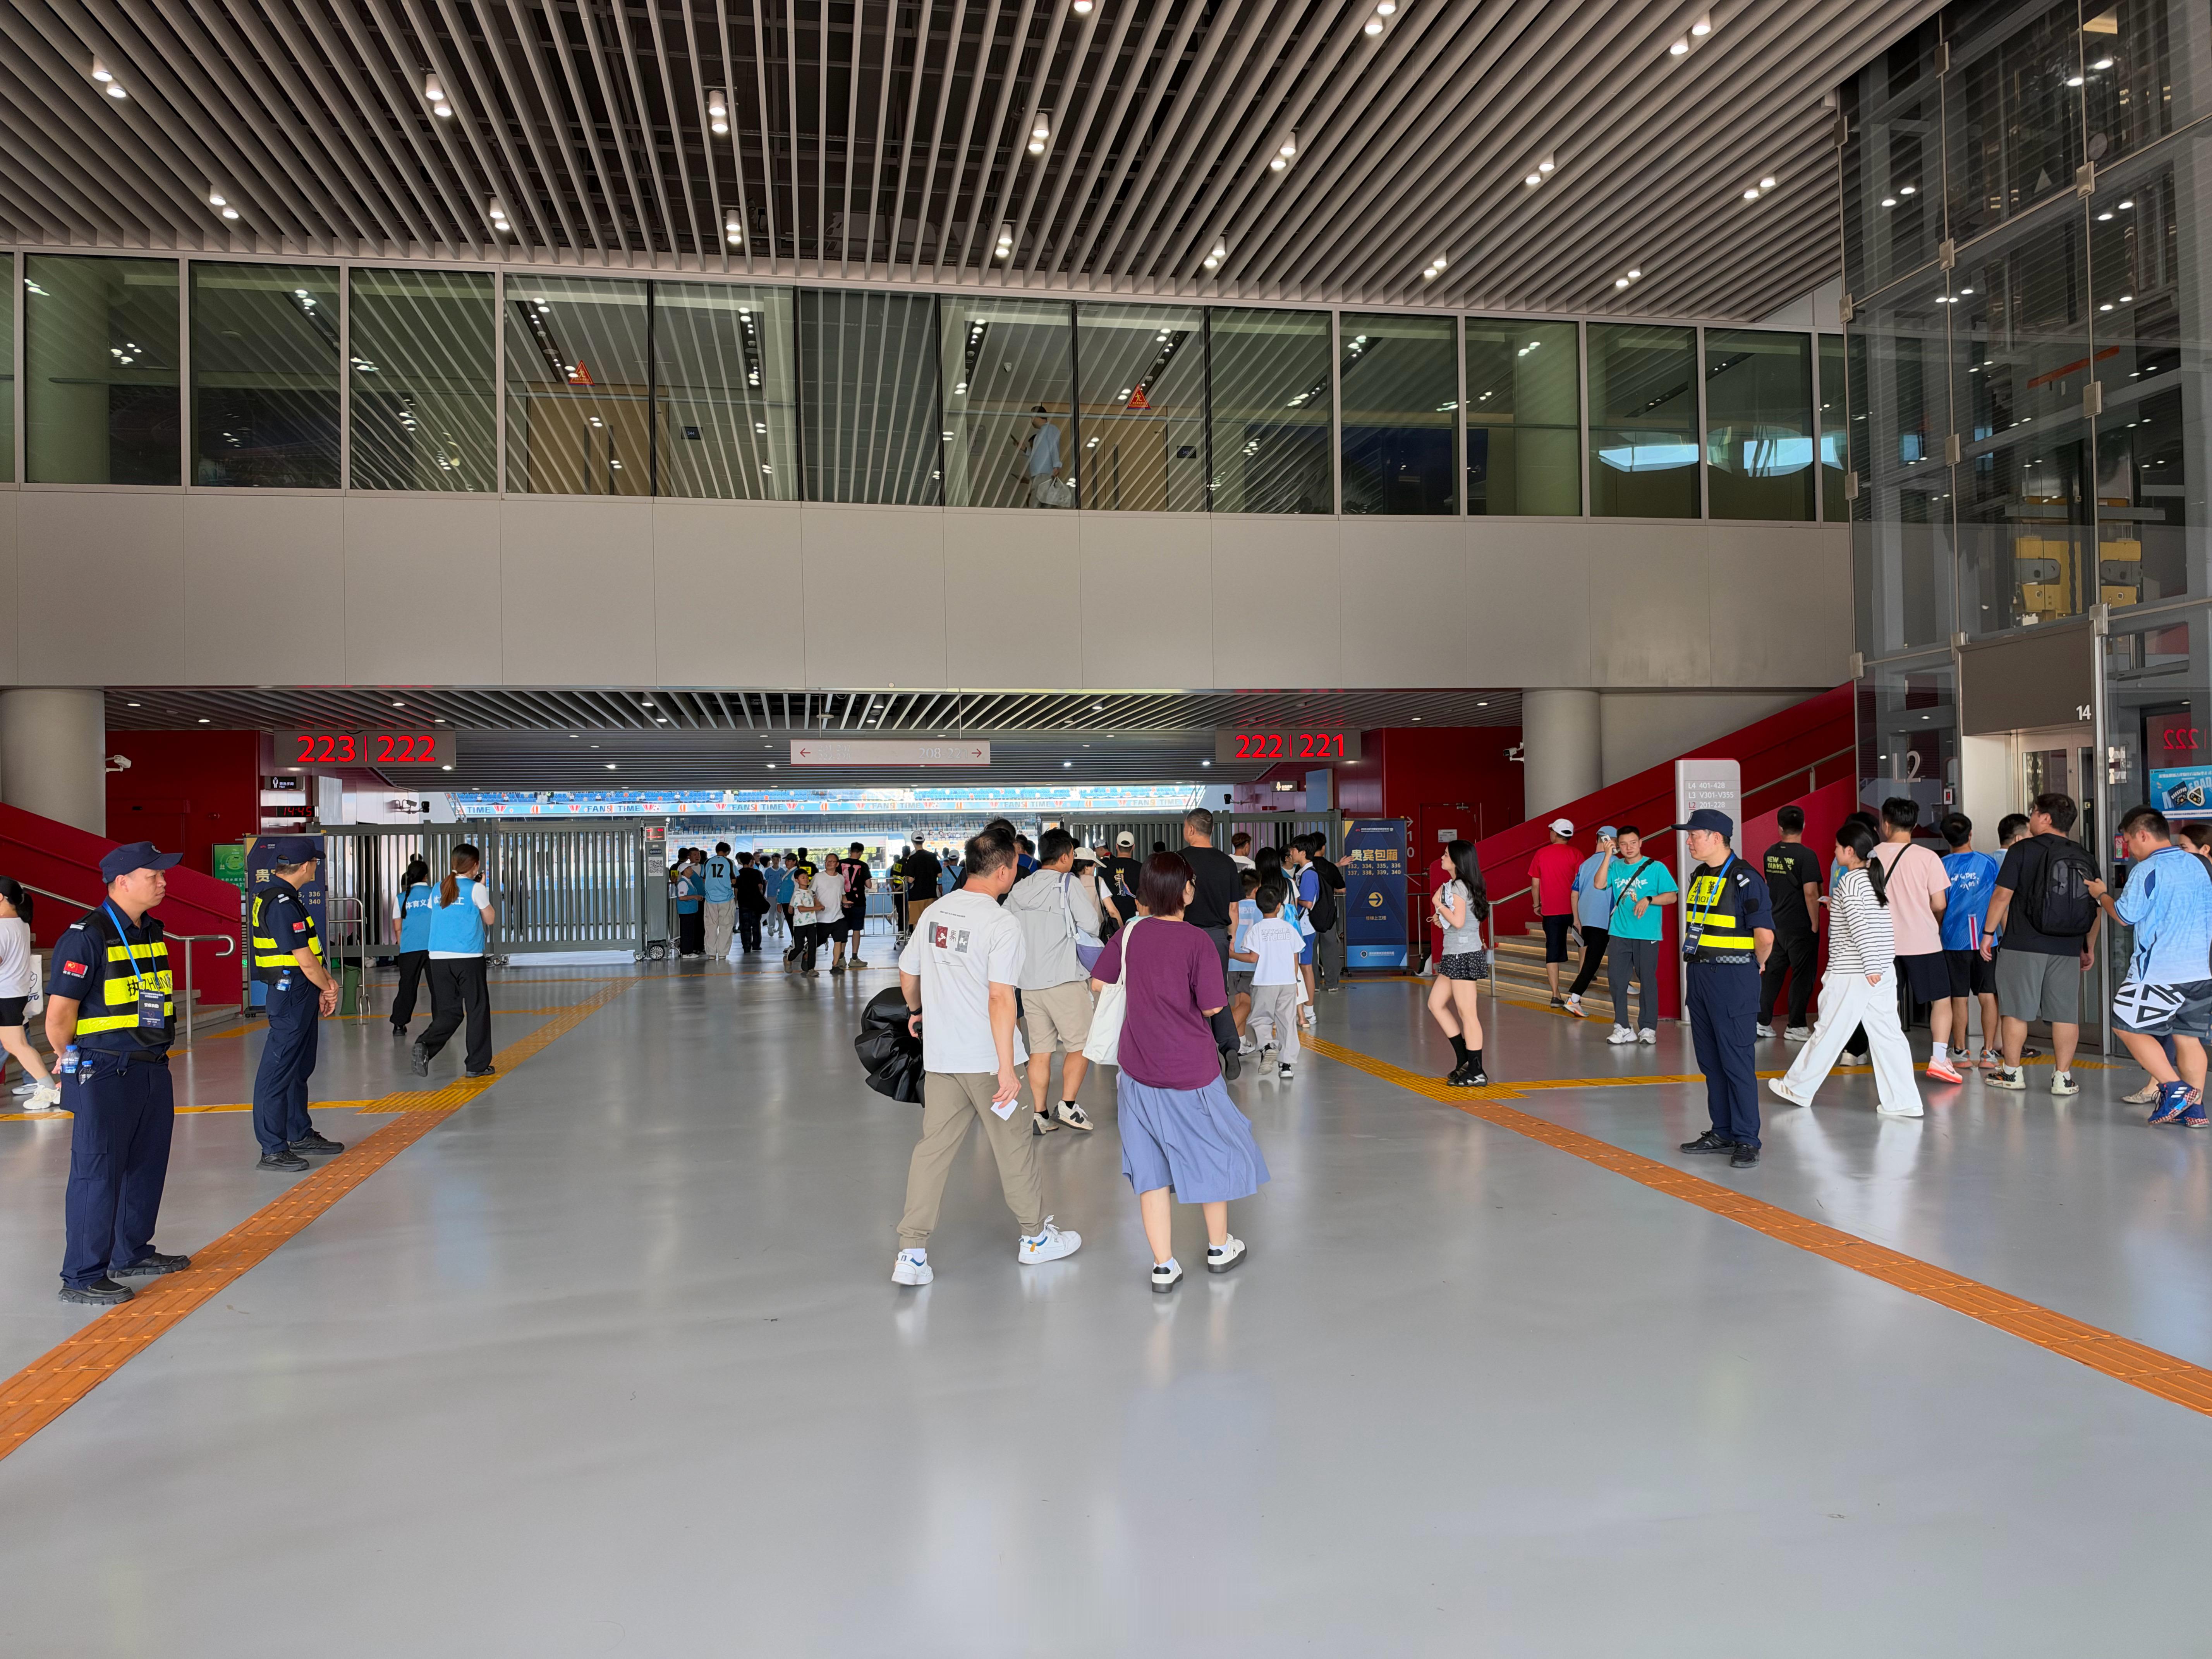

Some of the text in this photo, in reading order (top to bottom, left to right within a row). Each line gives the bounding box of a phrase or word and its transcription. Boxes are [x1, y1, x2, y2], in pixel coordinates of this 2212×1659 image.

[2076, 704, 2091, 721] 14
[297, 735, 436, 763] 223 222
[1235, 733, 1344, 758] 222 221
[1892, 750, 1922, 783] L2
[283, 806, 312, 816] 14:45
[1351, 849, 1398, 861] 贵宾包厢
[711, 864, 724, 878] 12
[407, 898, 430, 909] 体育义
